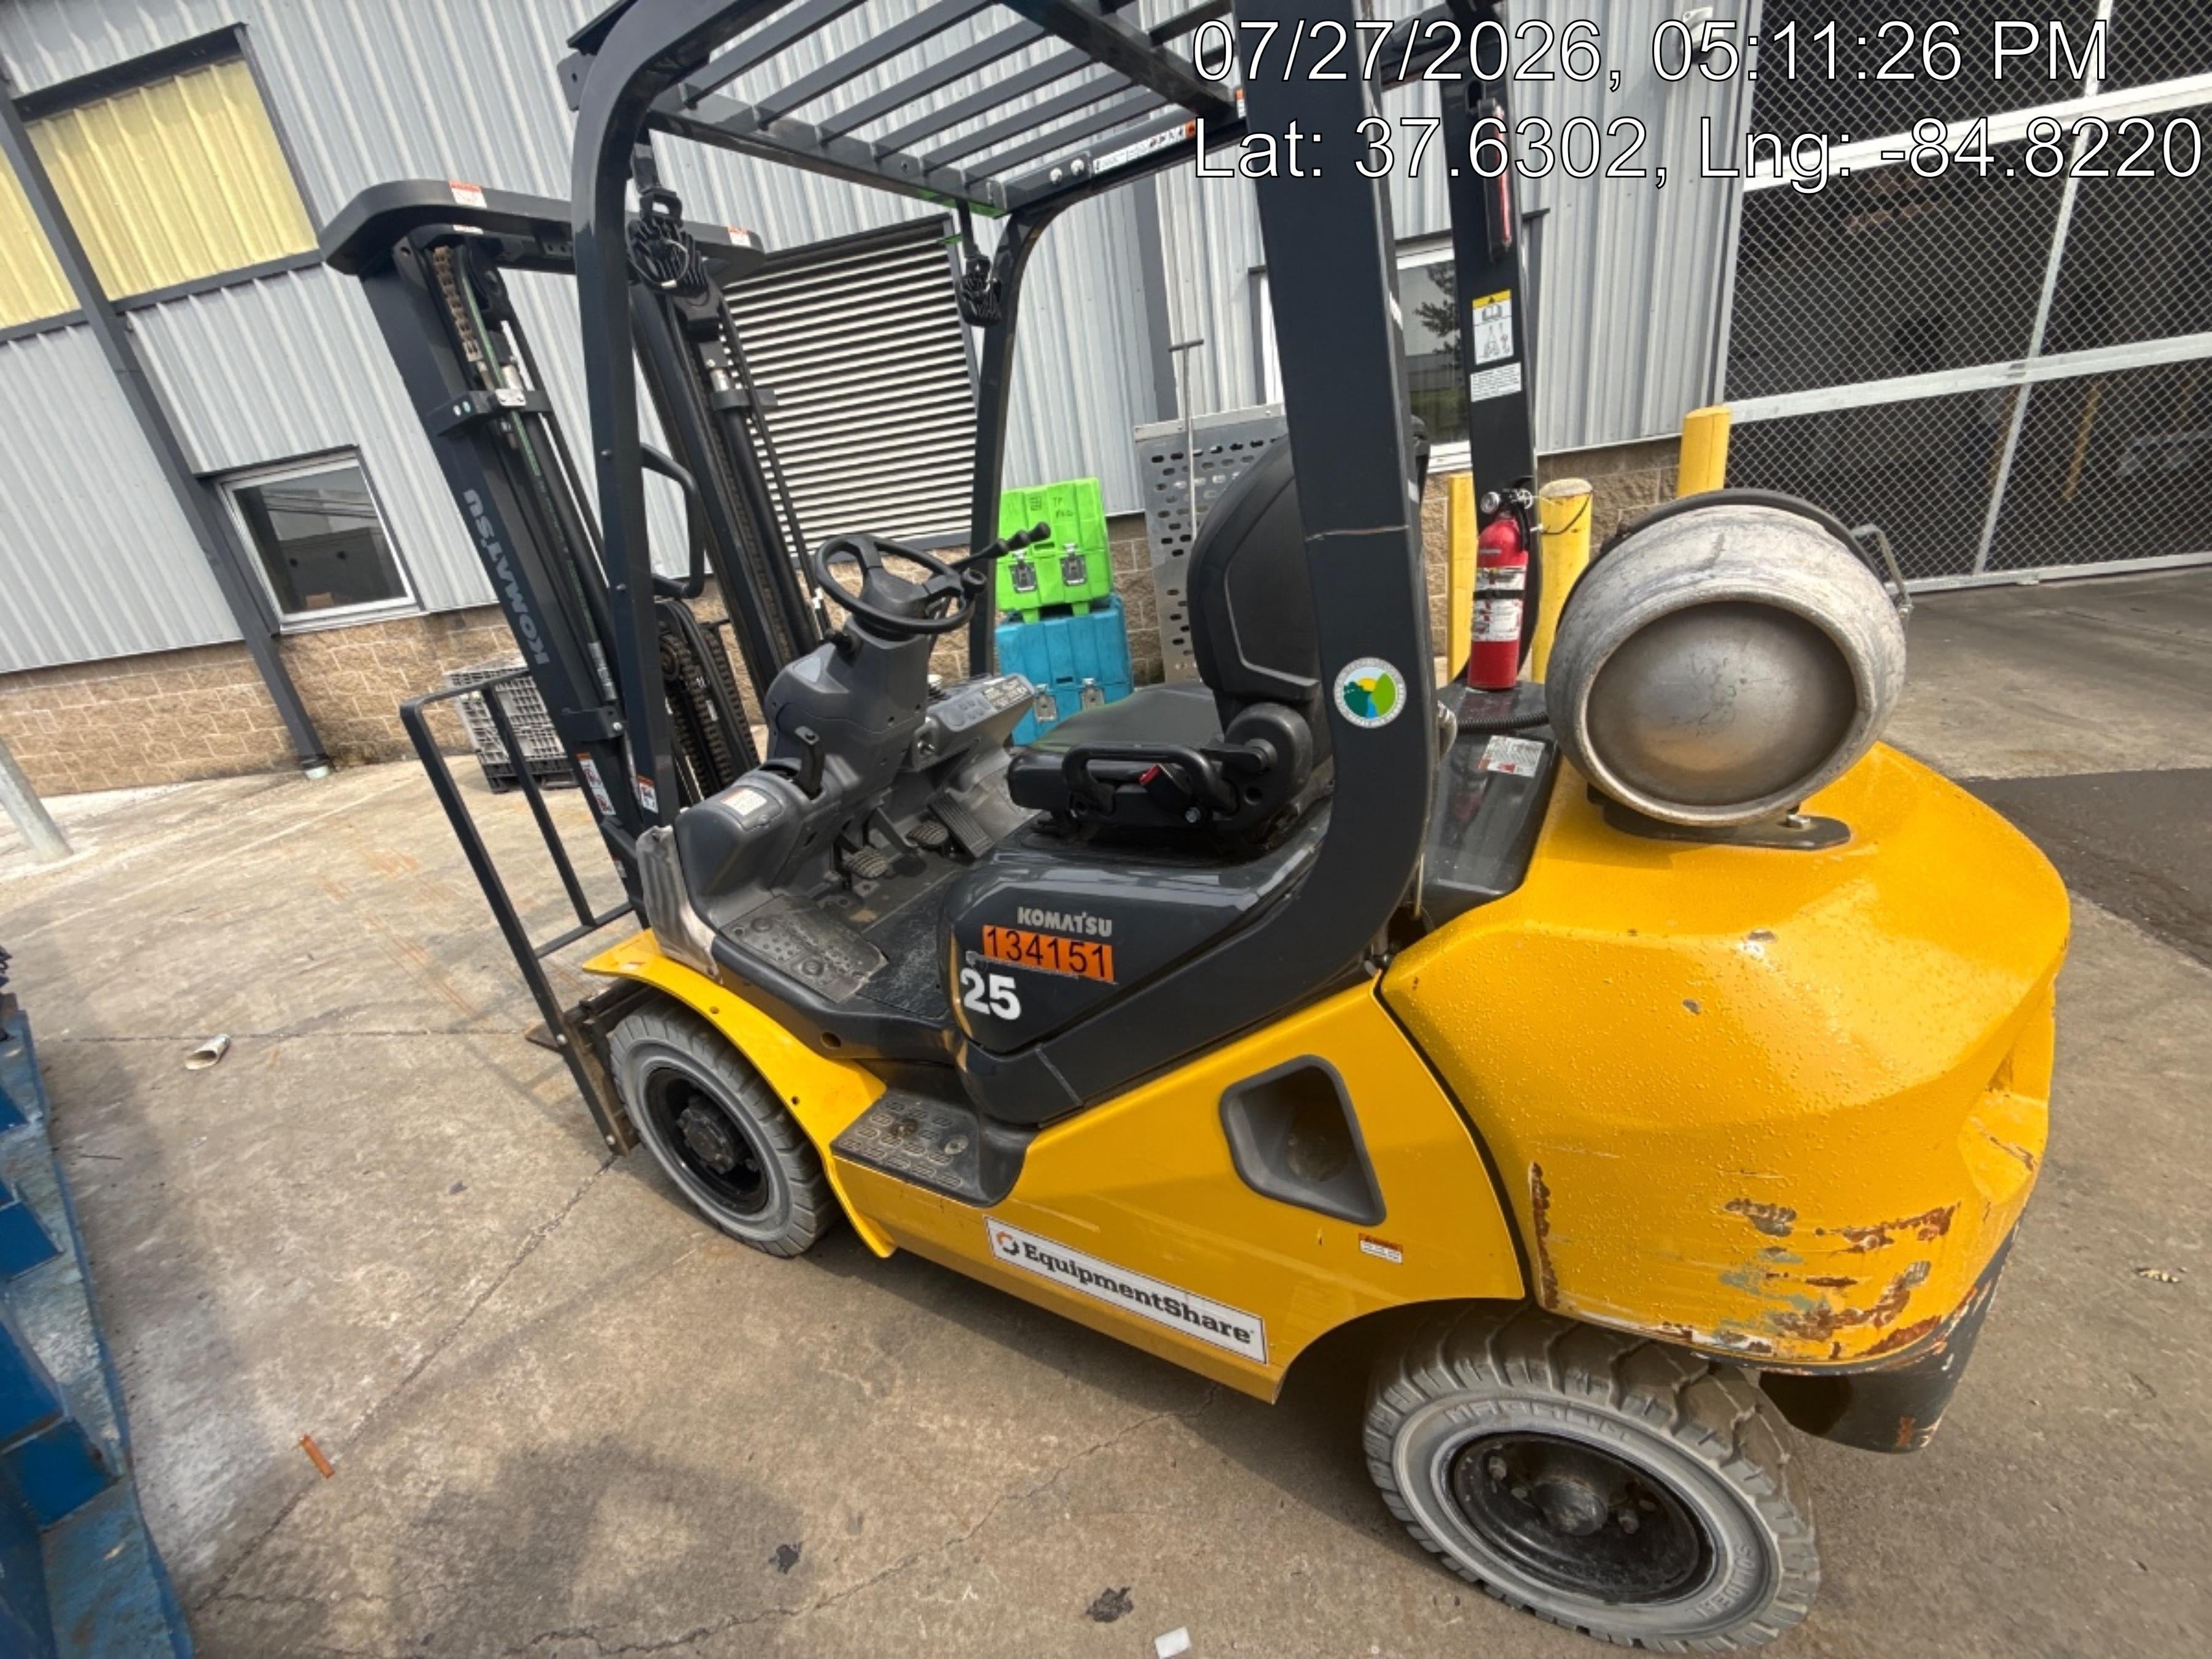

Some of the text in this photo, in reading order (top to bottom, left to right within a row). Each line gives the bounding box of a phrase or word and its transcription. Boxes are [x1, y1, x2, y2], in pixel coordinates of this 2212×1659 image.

[463, 488, 551, 665] KOMATSU
[1017, 906, 1113, 938] KOMATSU
[986, 927, 1105, 978] 134151
[960, 967, 1021, 1020] 25
[1021, 1241, 1253, 1345] EquipmentShare
